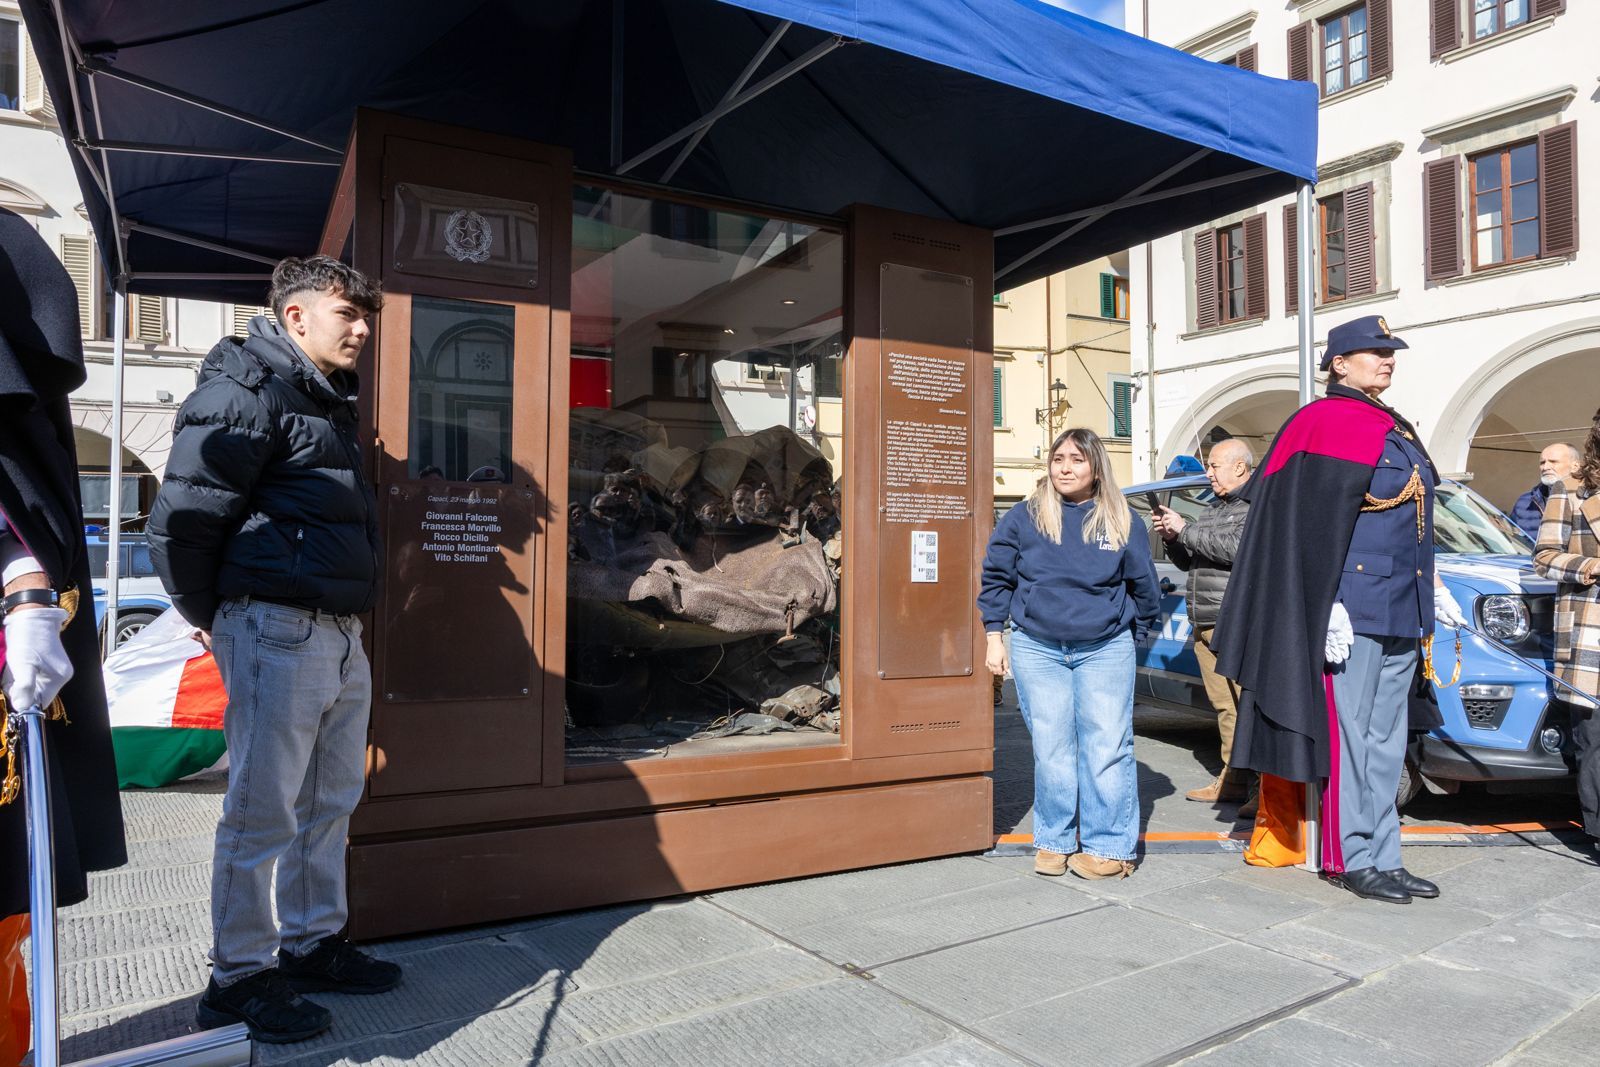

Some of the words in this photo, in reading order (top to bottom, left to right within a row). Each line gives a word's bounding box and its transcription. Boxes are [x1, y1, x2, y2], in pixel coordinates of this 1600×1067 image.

[482, 497, 497, 505] 1992
[425, 511, 463, 521] Giovanni
[465, 513, 498, 522] Falcone
[421, 521, 466, 531] Francesca
[467, 523, 502, 533] Morvillo
[433, 532, 461, 541] Rocco
[463, 533, 489, 542] Dicillo
[422, 543, 455, 552] Antonio
[457, 543, 500, 553] Montinaro
[434, 553, 452, 562] Vito
[453, 553, 488, 563] Schifani
